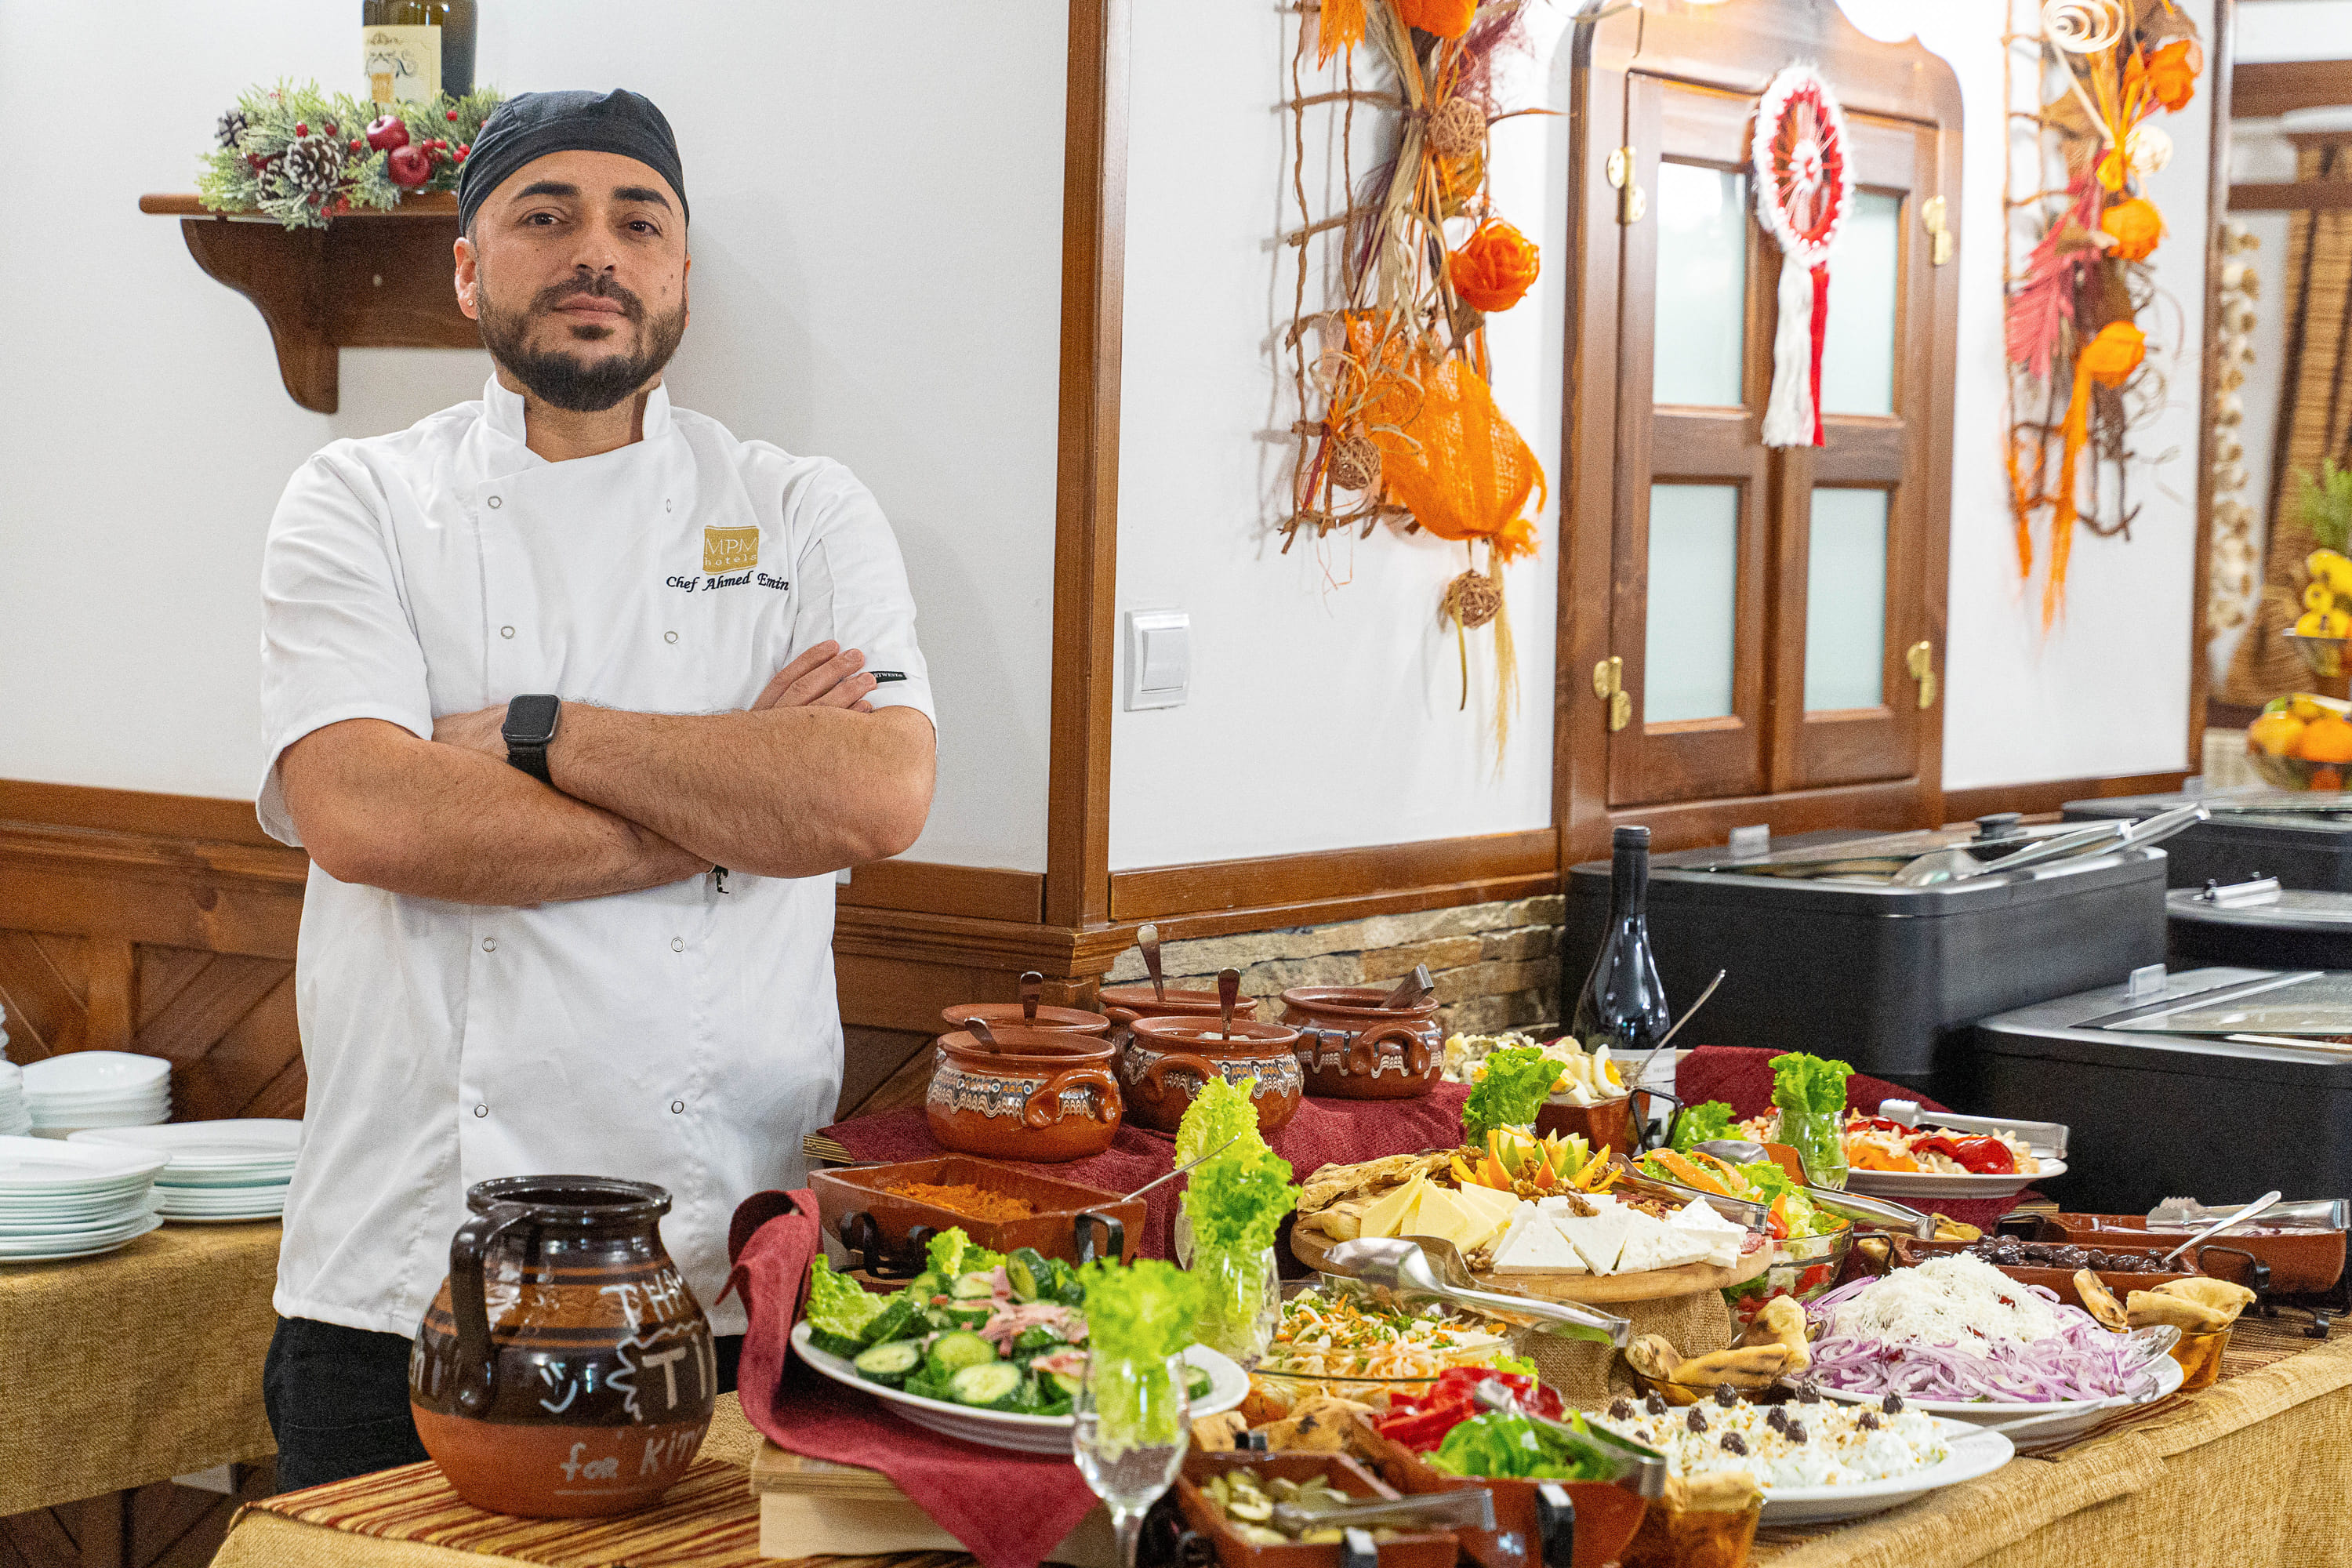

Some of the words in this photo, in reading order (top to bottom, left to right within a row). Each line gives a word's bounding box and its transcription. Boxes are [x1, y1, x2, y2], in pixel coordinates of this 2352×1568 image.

[705, 538, 757, 555] MPM
[704, 554, 757, 566] hotels
[666, 575, 700, 593] Chef
[702, 570, 753, 591] Ahmed
[757, 573, 789, 591] Emin
